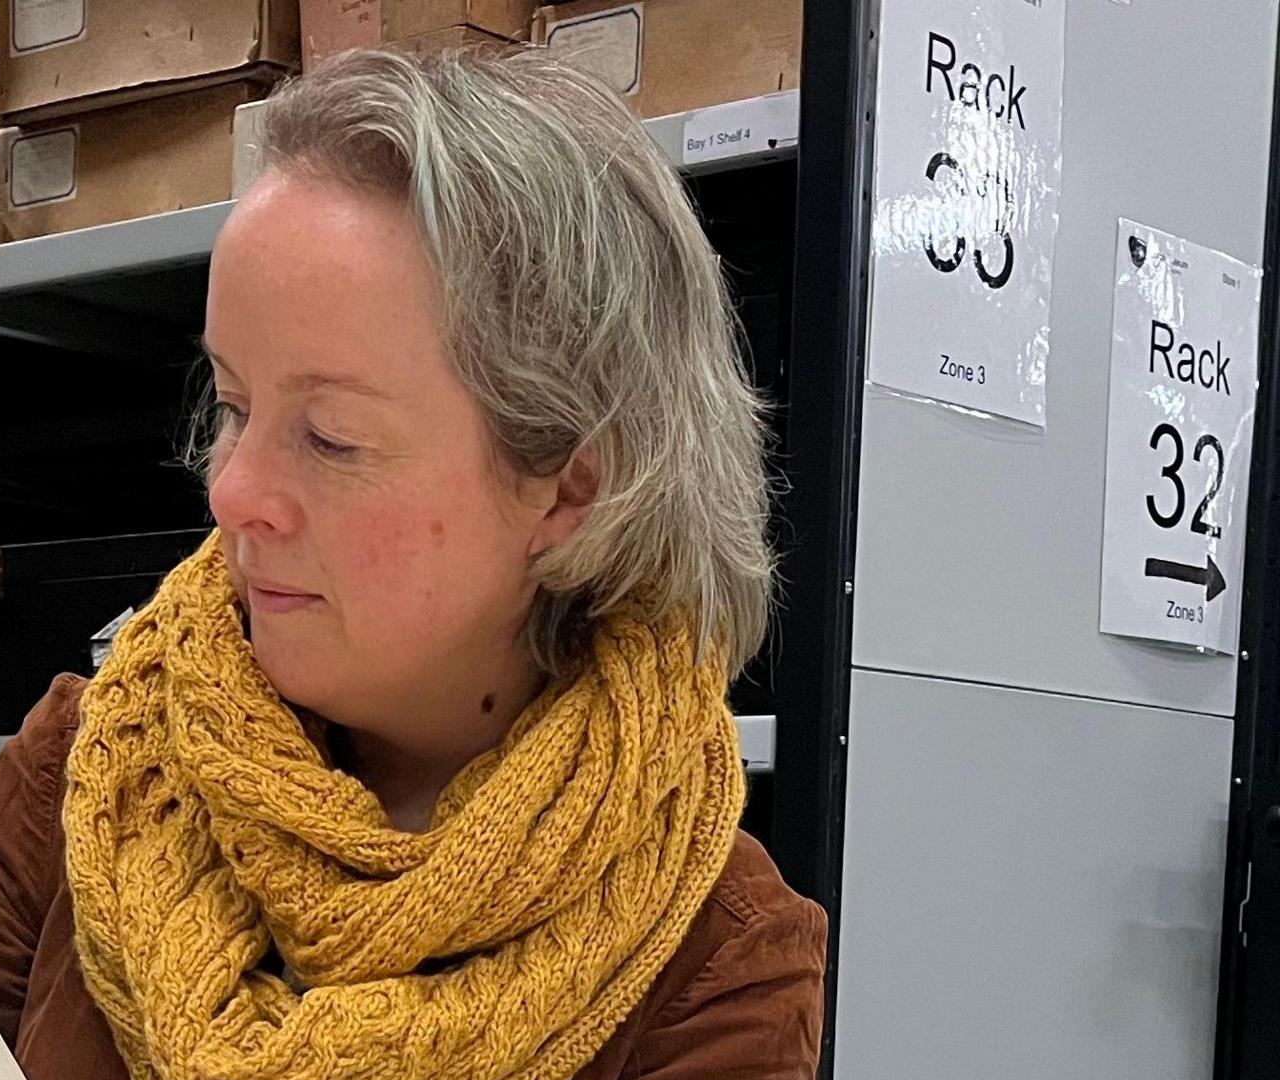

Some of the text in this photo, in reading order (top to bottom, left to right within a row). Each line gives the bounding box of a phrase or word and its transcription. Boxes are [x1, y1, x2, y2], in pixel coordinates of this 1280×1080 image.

[926, 31, 1027, 130] Rack
[687, 138, 706, 151] Bay
[716, 128, 743, 146] Shelf
[940, 354, 986, 384] Zone 3
[1150, 319, 1231, 396] Rack
[1146, 423, 1225, 540] 32
[1166, 600, 1204, 624] Zone 3
